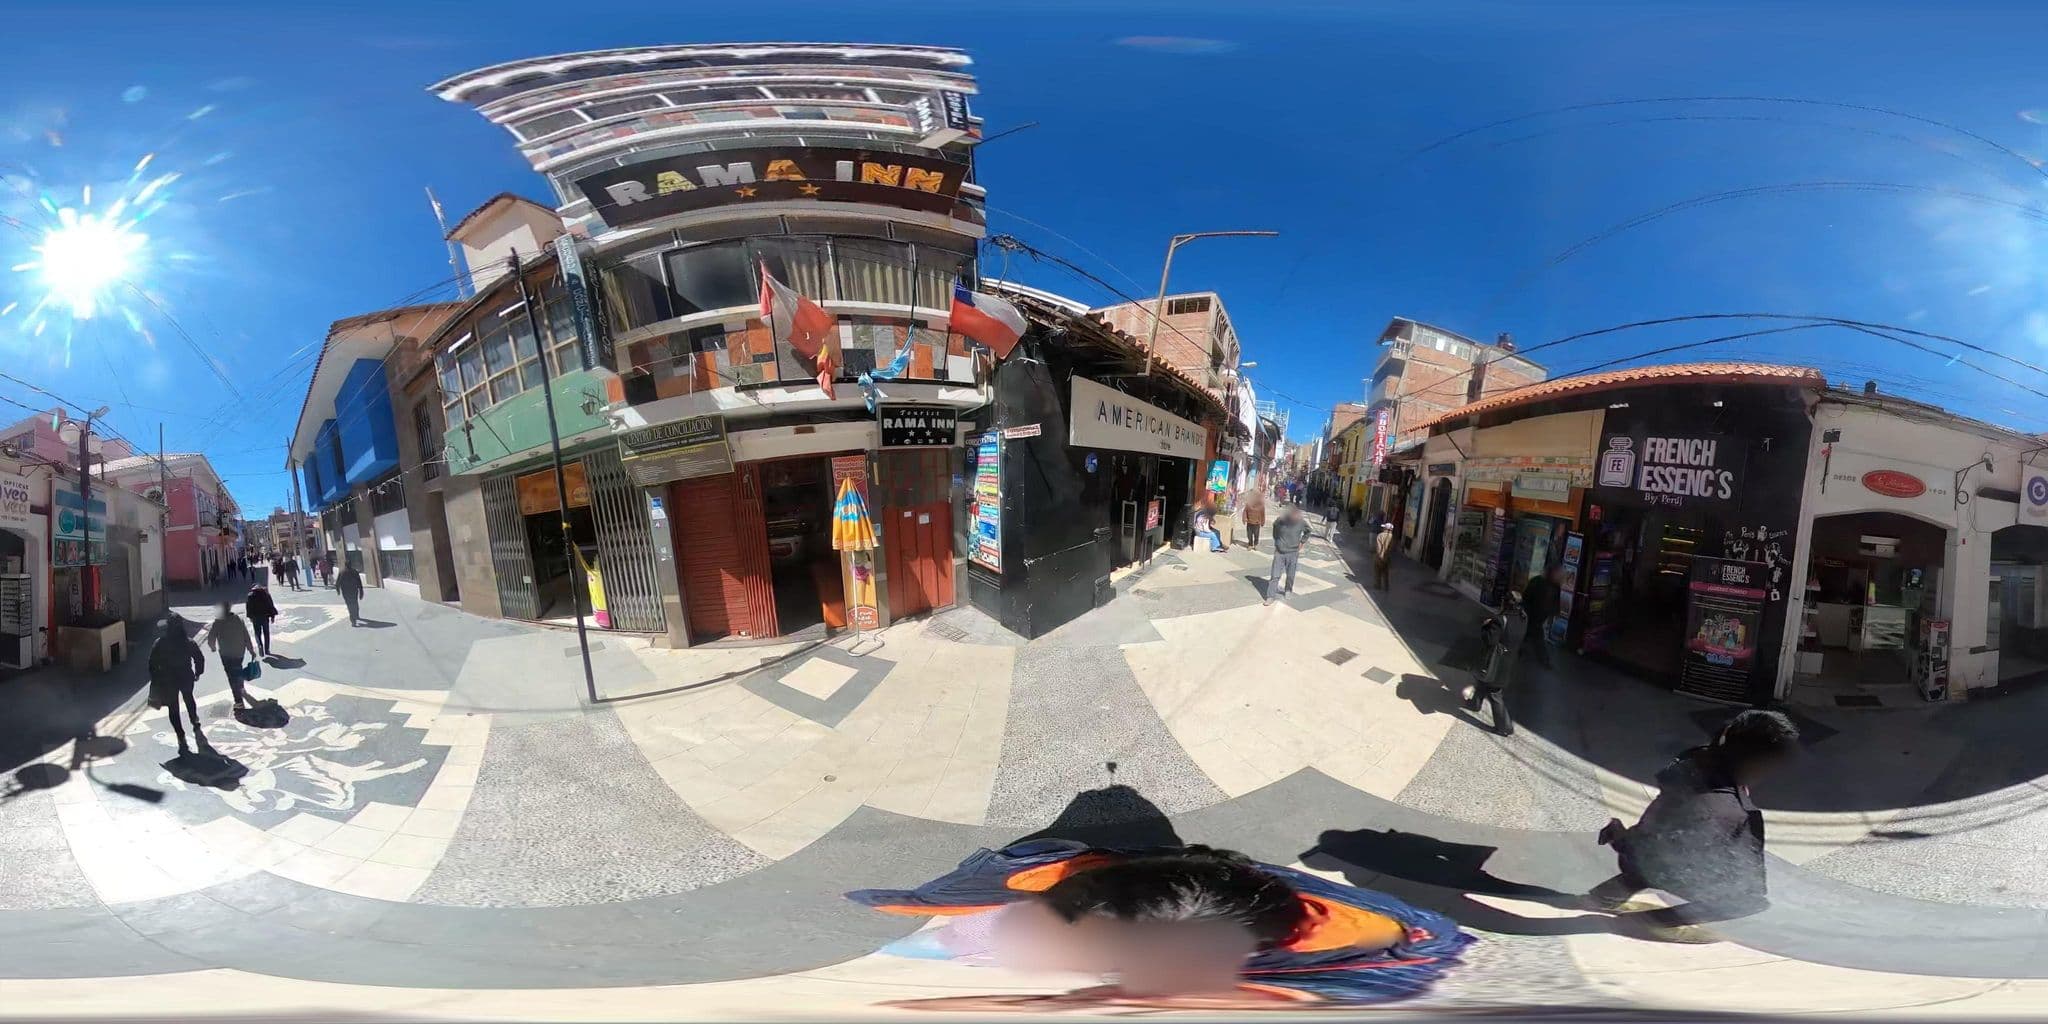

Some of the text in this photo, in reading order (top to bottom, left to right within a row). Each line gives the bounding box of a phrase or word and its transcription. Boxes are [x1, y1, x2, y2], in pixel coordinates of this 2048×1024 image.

[604, 158, 945, 208] RAMA INN
[883, 418, 955, 429] RAMA INN
[1097, 400, 1204, 447] AMERICAN BRANDS
[627, 430, 652, 446] CENTRO
[654, 427, 663, 440] DE
[1644, 437, 1717, 467] FRENCH
[1610, 459, 1623, 471] FE
[1644, 493, 1658, 505] By
[1722, 564, 1746, 575] FRENCH
